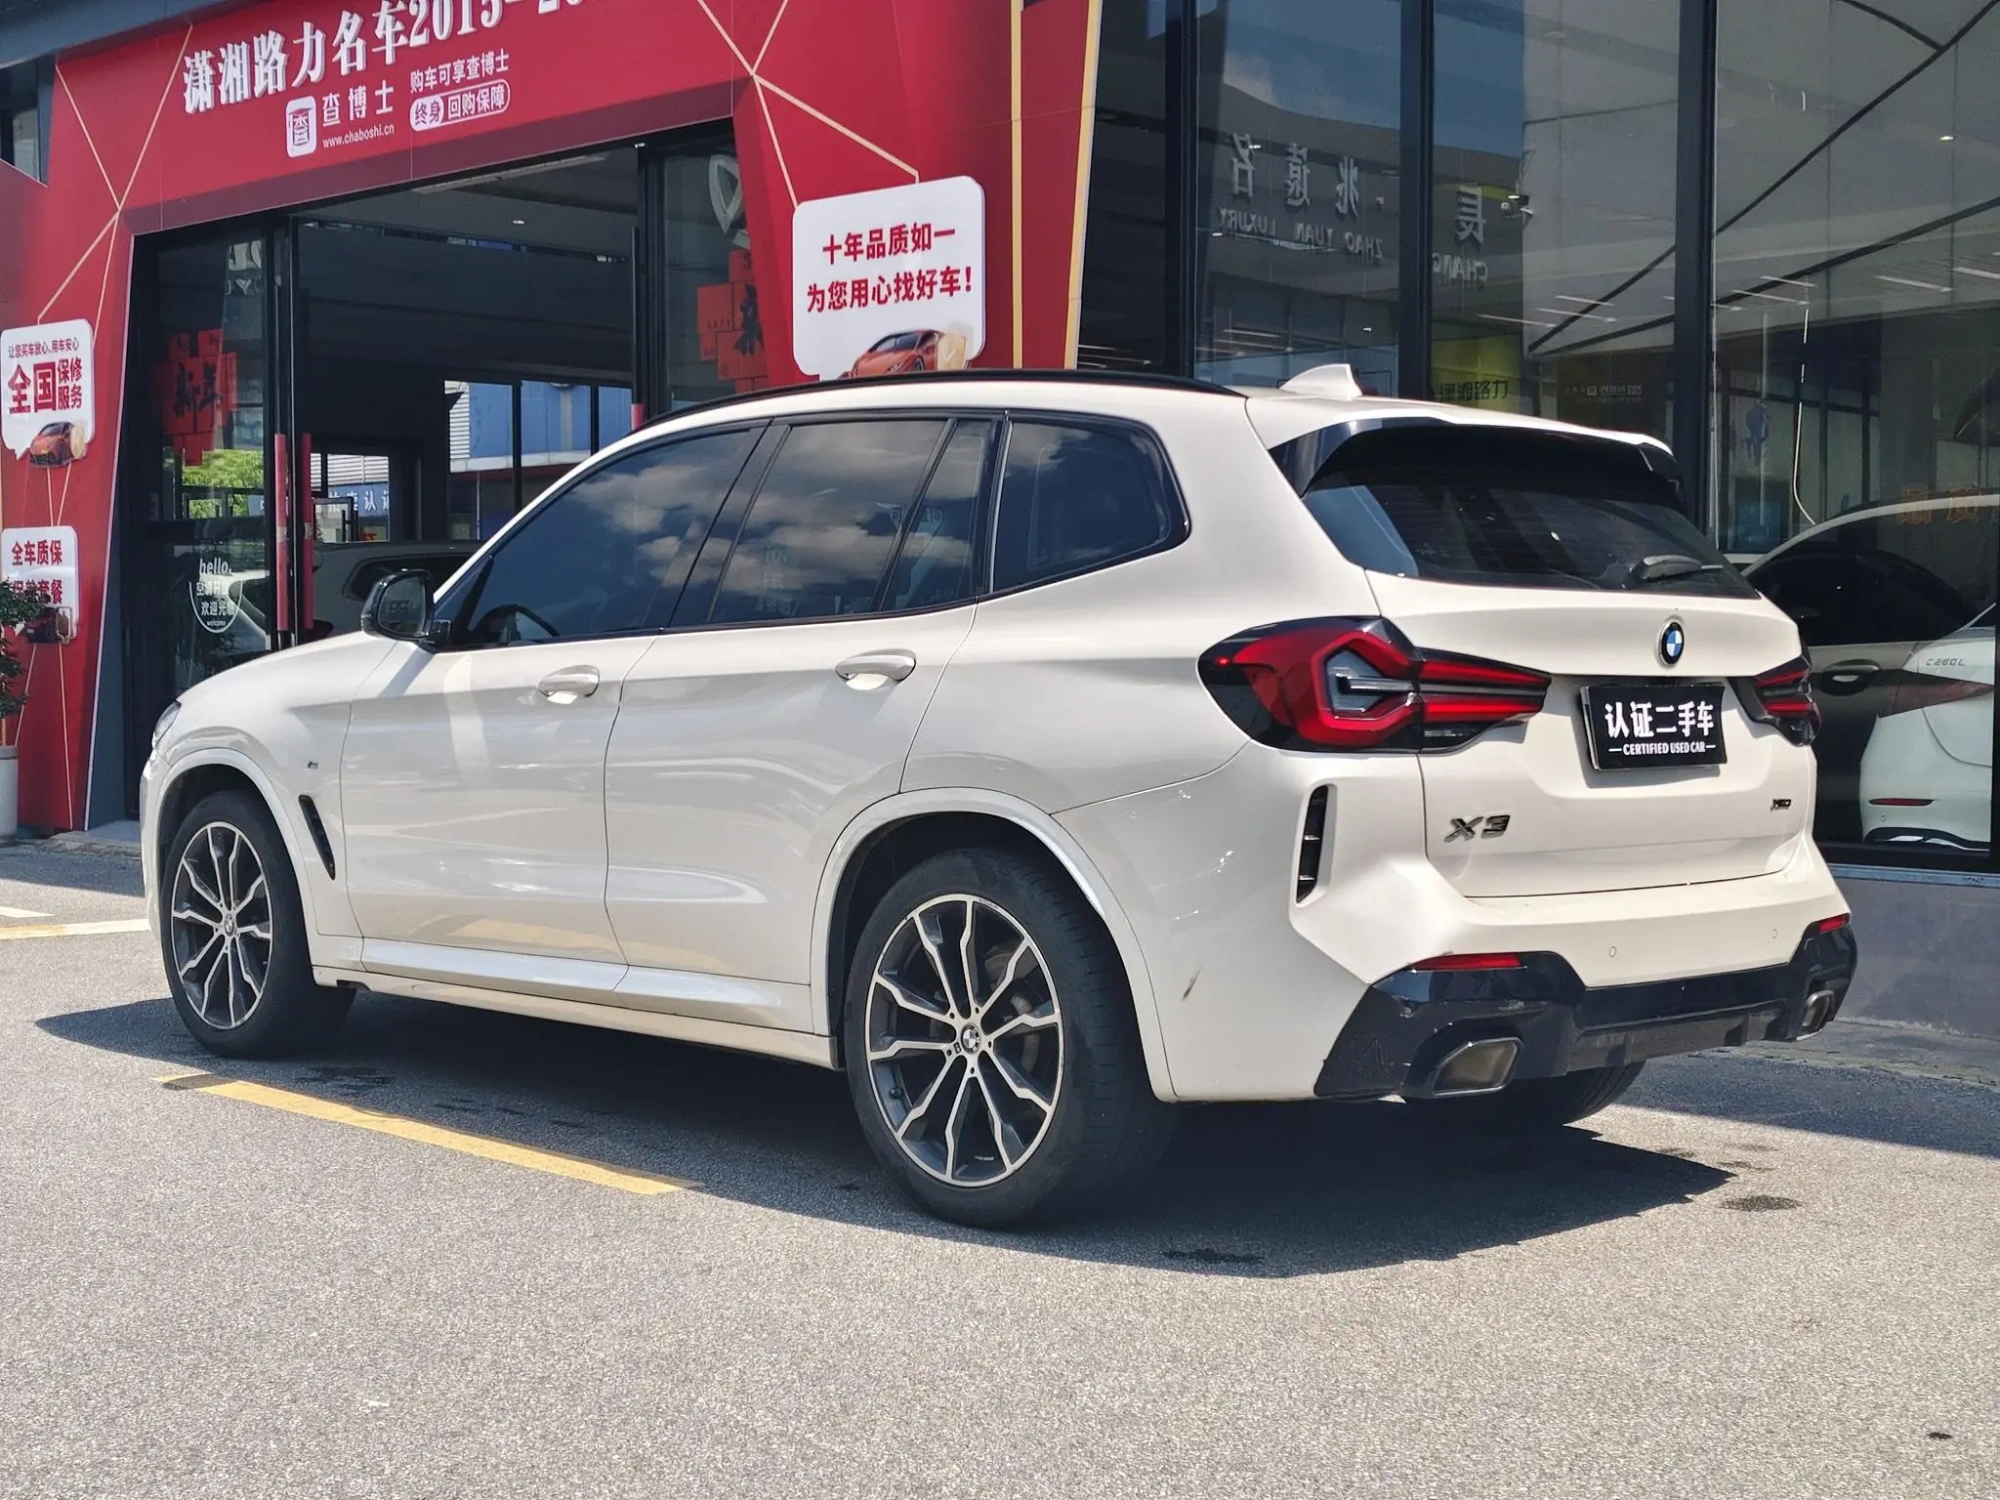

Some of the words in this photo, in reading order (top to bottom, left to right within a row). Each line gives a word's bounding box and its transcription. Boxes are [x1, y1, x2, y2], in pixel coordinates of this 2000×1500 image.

[410, 47, 510, 94] 购车可享查博士
[322, 79, 395, 127] 查博士
[414, 100, 441, 126] 终身
[447, 84, 506, 120] 回购保障
[322, 124, 395, 149] www.chaboshi.cn
[822, 222, 956, 265] 十年品质如一
[807, 265, 972, 313] 为您用心找好车!
[7, 361, 57, 415] 全国
[57, 356, 83, 384] 保修
[57, 384, 83, 411] 服务
[11, 539, 63, 566] 全车质保
[1604, 700, 1714, 738] 认证二手车
[1622, 742, 1669, 756] CERTIFIED
[1669, 741, 1690, 754] USED
[1690, 740, 1706, 753] CAR
[1443, 814, 1511, 844] X3
